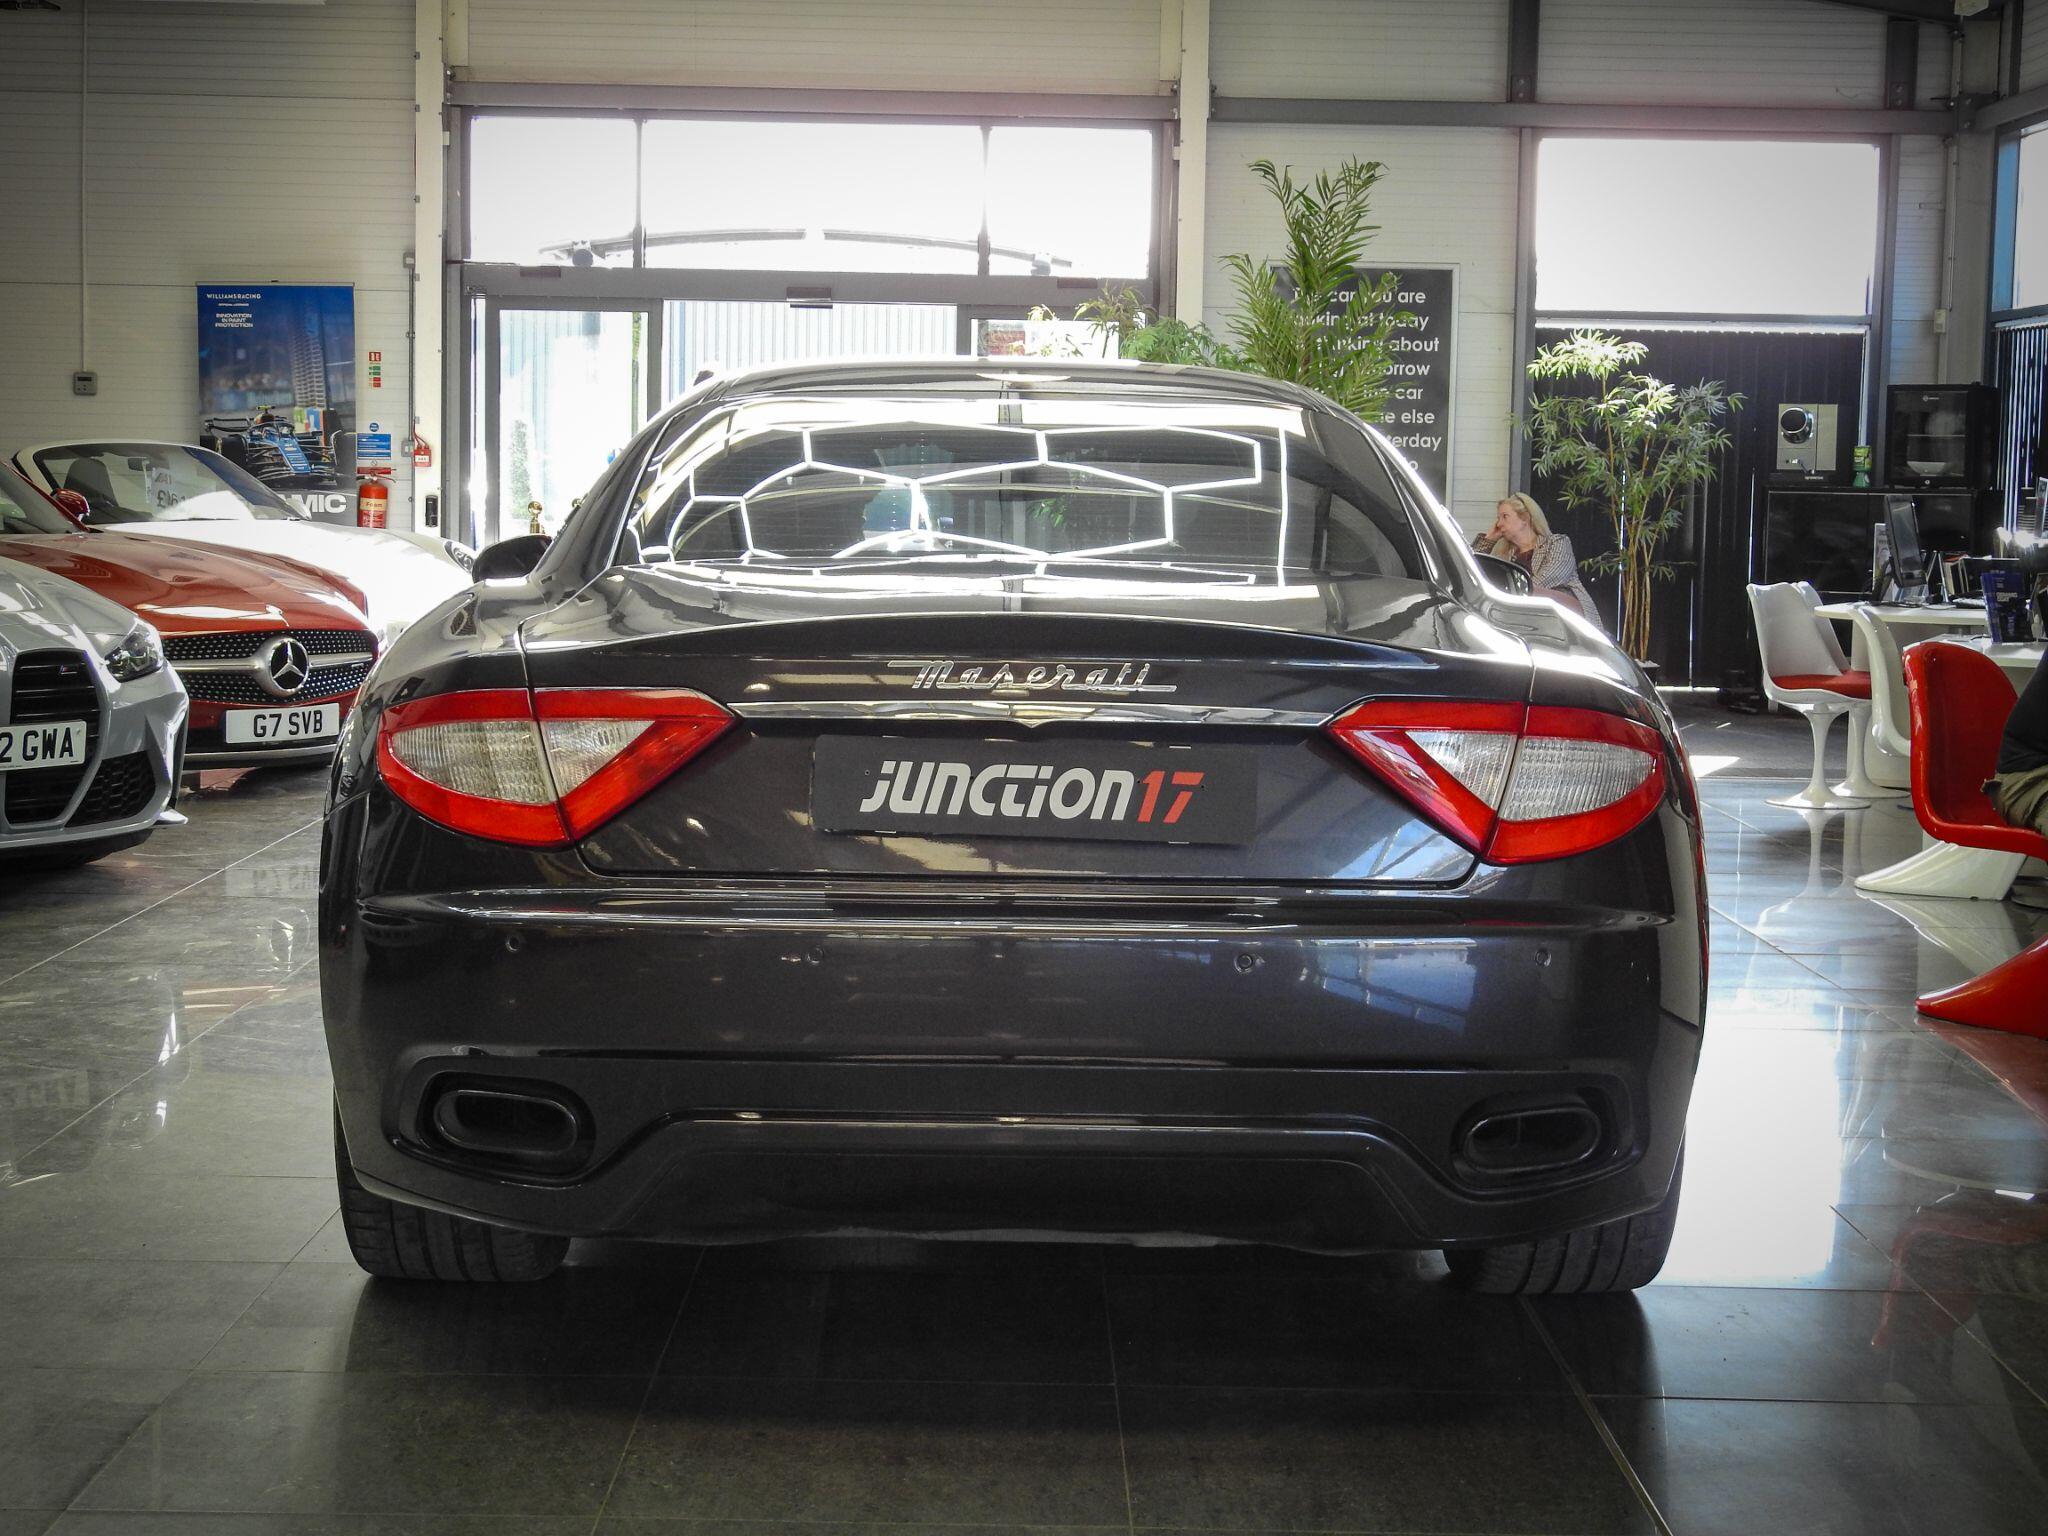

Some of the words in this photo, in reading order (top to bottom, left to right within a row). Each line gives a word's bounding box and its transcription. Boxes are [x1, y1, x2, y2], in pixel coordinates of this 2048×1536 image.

[1397, 290, 1427, 304] are
[1389, 336, 1440, 352] about
[1395, 387, 1424, 401] car
[1401, 408, 1435, 424] else
[887, 659, 1178, 693] Maserati
[253, 713, 282, 738] G7
[288, 709, 323, 736] SVB
[0, 731, 13, 763] 2
[22, 726, 74, 761] GWA
